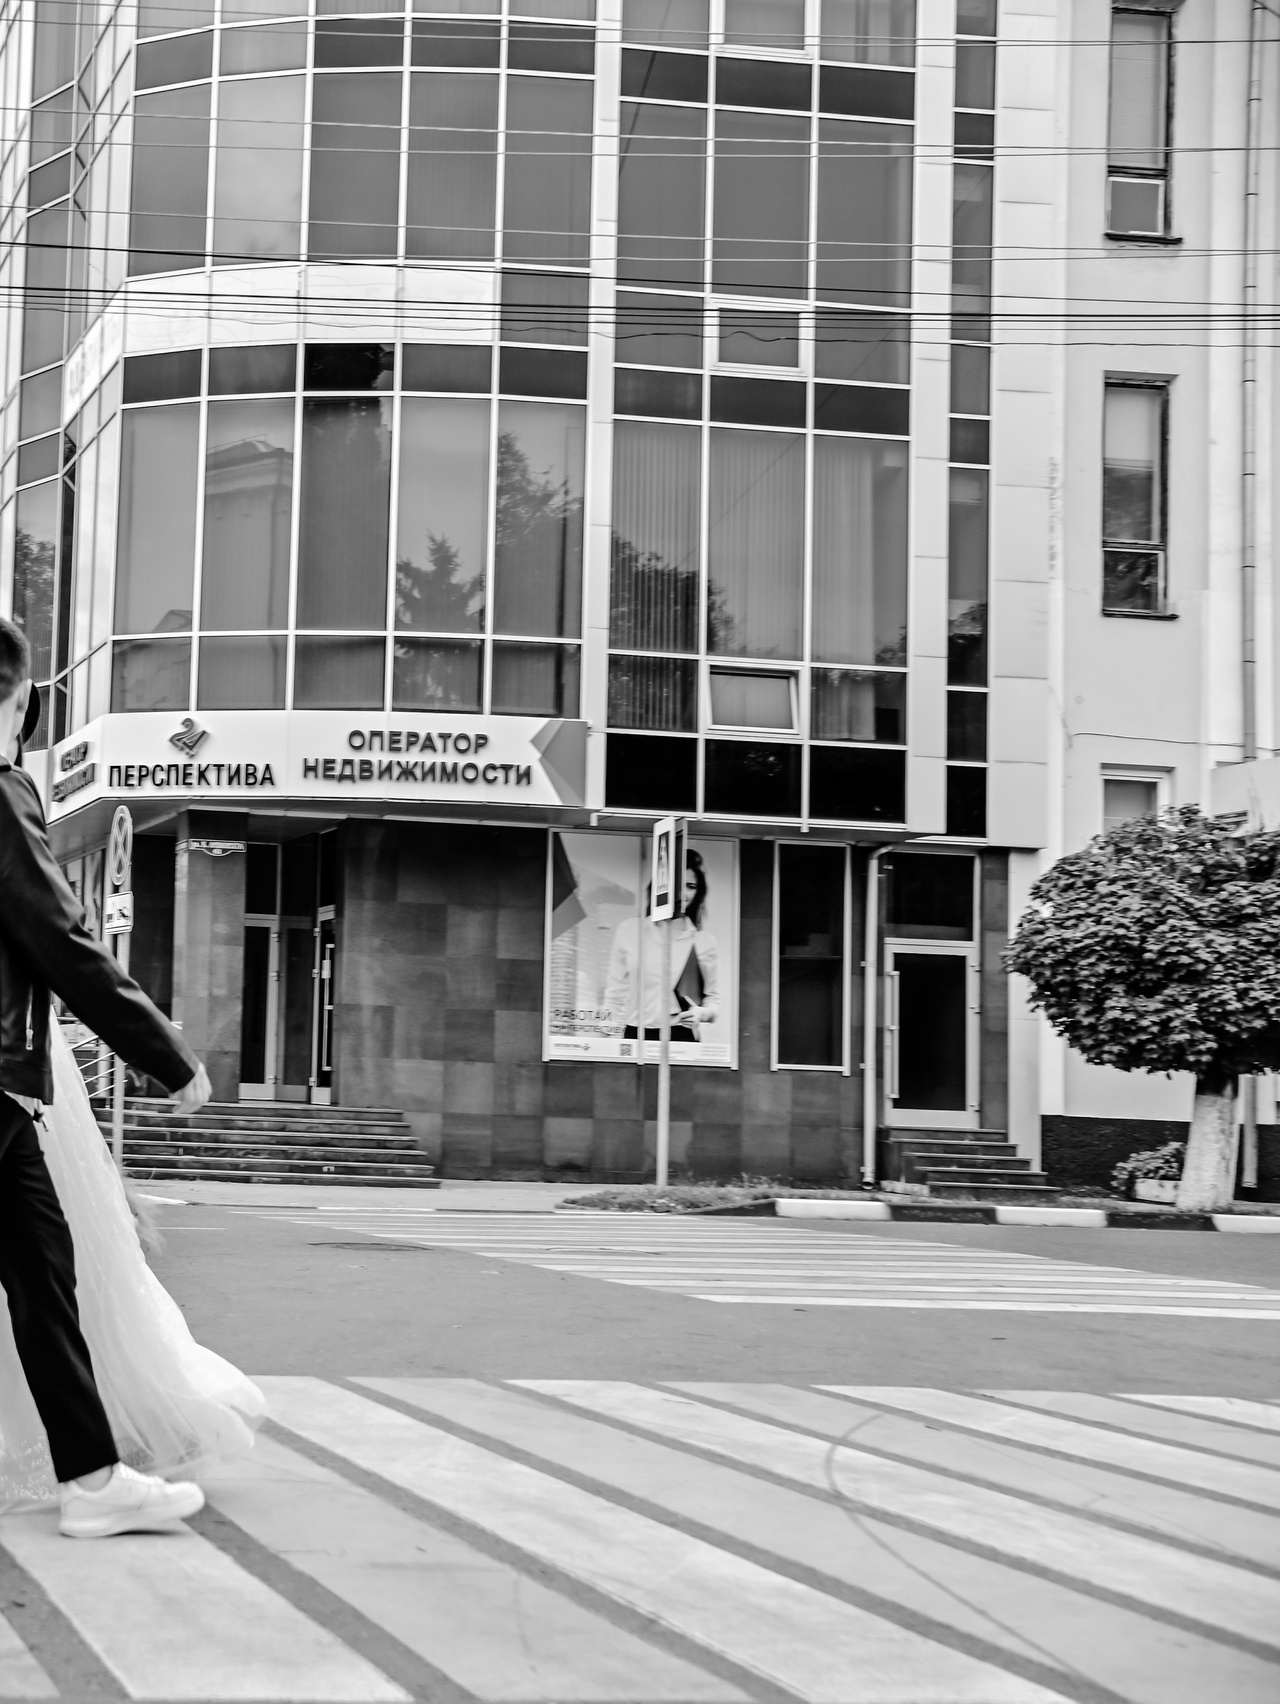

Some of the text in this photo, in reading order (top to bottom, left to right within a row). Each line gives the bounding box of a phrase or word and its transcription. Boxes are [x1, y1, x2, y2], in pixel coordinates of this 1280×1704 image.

[348, 729, 489, 754] ОПЕРАТОР
[107, 763, 275, 788] ПЕРСПЕКТИВА
[303, 757, 532, 786] НЕДВИЖИМОСТИ
[553, 1009, 613, 1022] РАБОТАЙ
